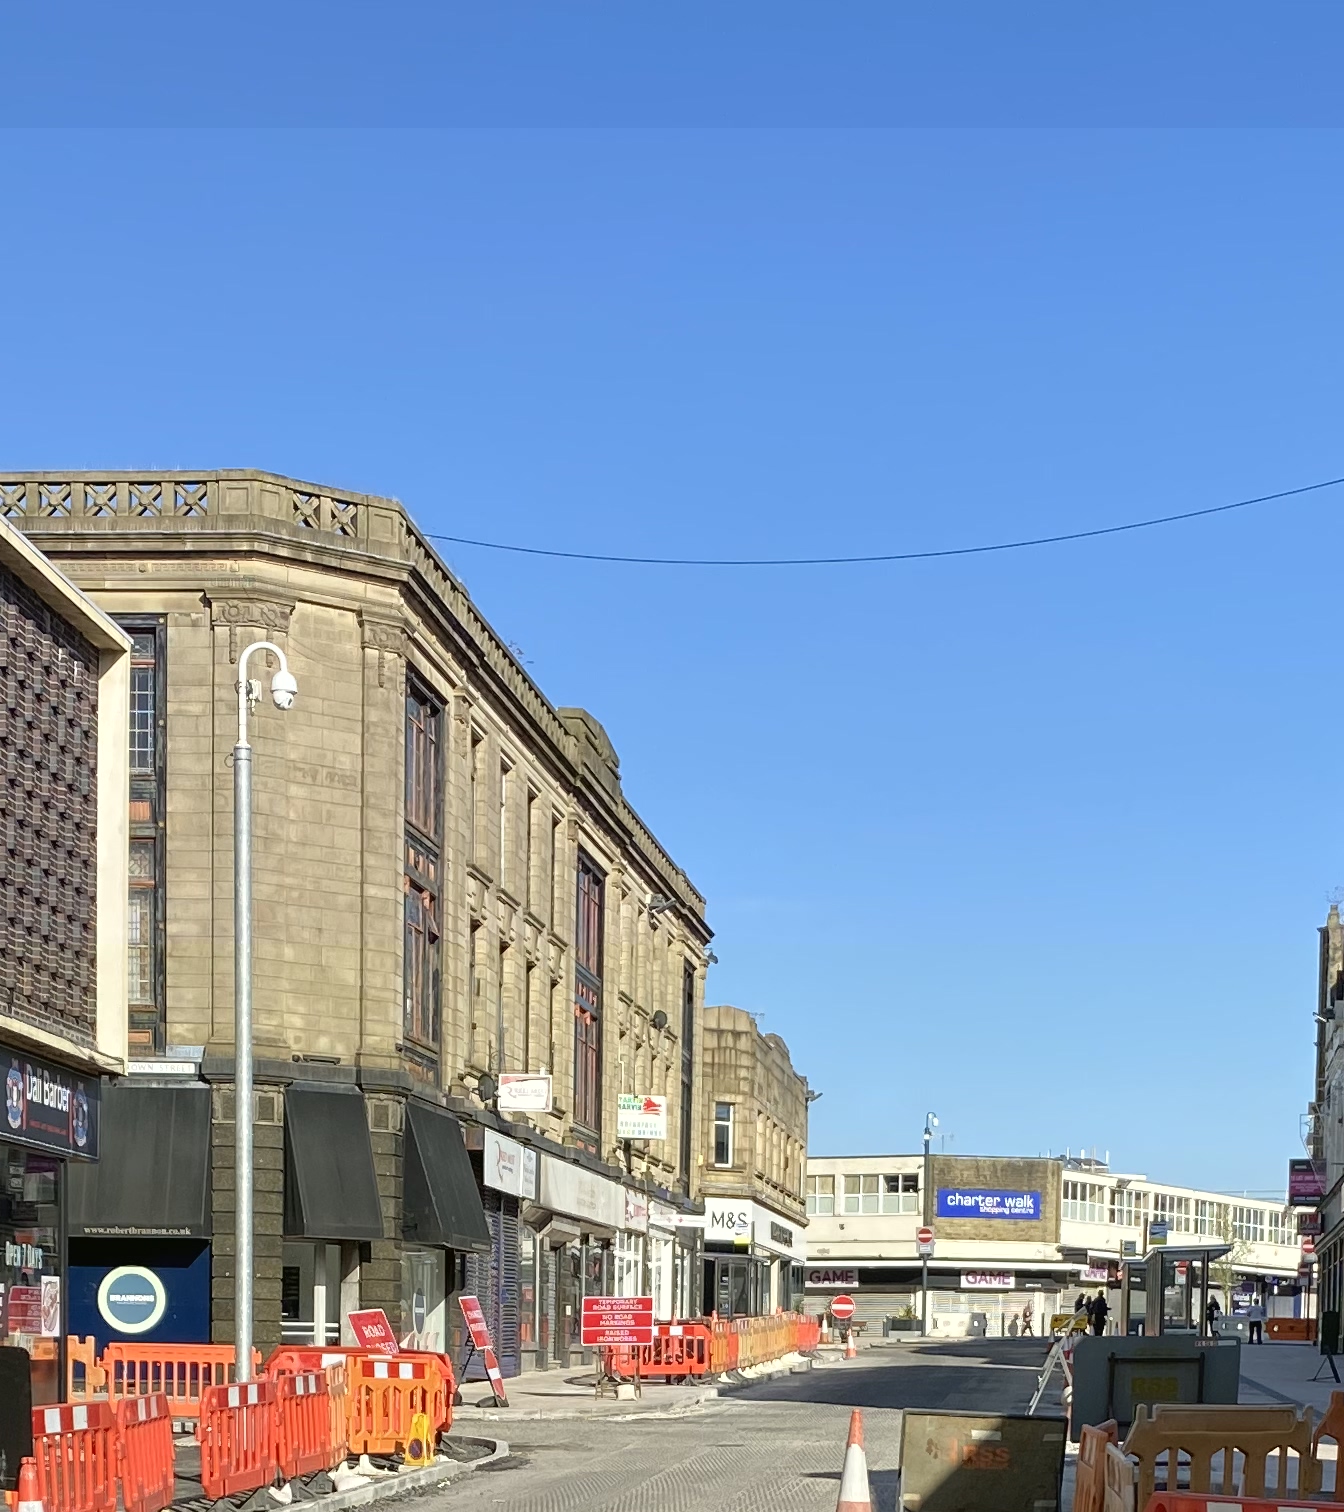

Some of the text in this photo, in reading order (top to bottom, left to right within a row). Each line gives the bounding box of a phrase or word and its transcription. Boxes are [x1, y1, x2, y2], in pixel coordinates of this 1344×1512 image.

[159, 1064, 192, 1073] STREET
[947, 1192, 1034, 1208] charter walk
[711, 1210, 748, 1230] M&S
[809, 1268, 854, 1285] GAME
[964, 1270, 1012, 1286] GAME
[361, 1323, 386, 1339] ROAD
[365, 1341, 400, 1355] OSED
